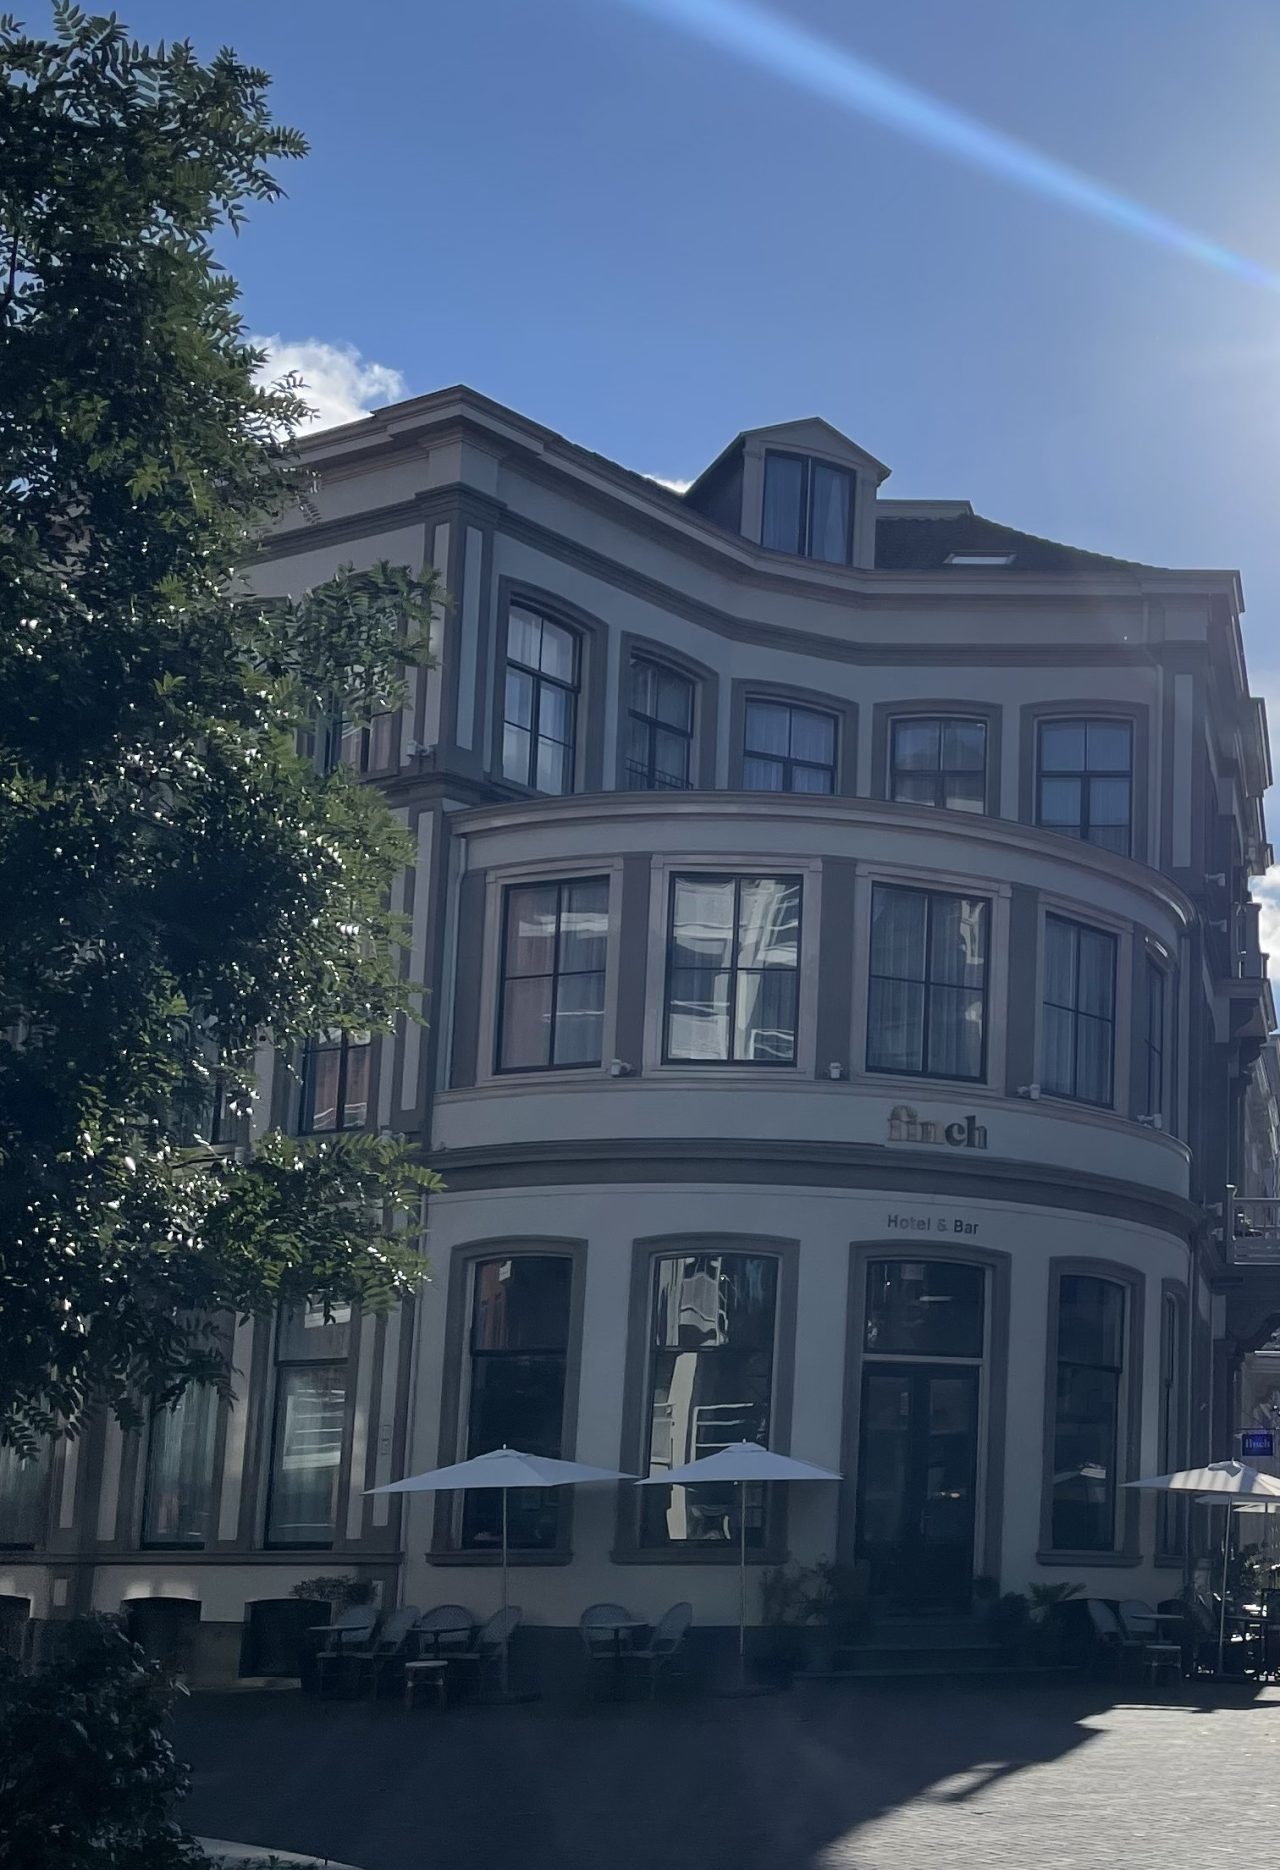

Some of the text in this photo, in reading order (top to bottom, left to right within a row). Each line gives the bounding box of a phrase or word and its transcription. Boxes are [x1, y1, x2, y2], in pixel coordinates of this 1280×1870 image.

[888, 1105, 988, 1149] finch
[887, 1214, 979, 1235] Hotel & Bar
